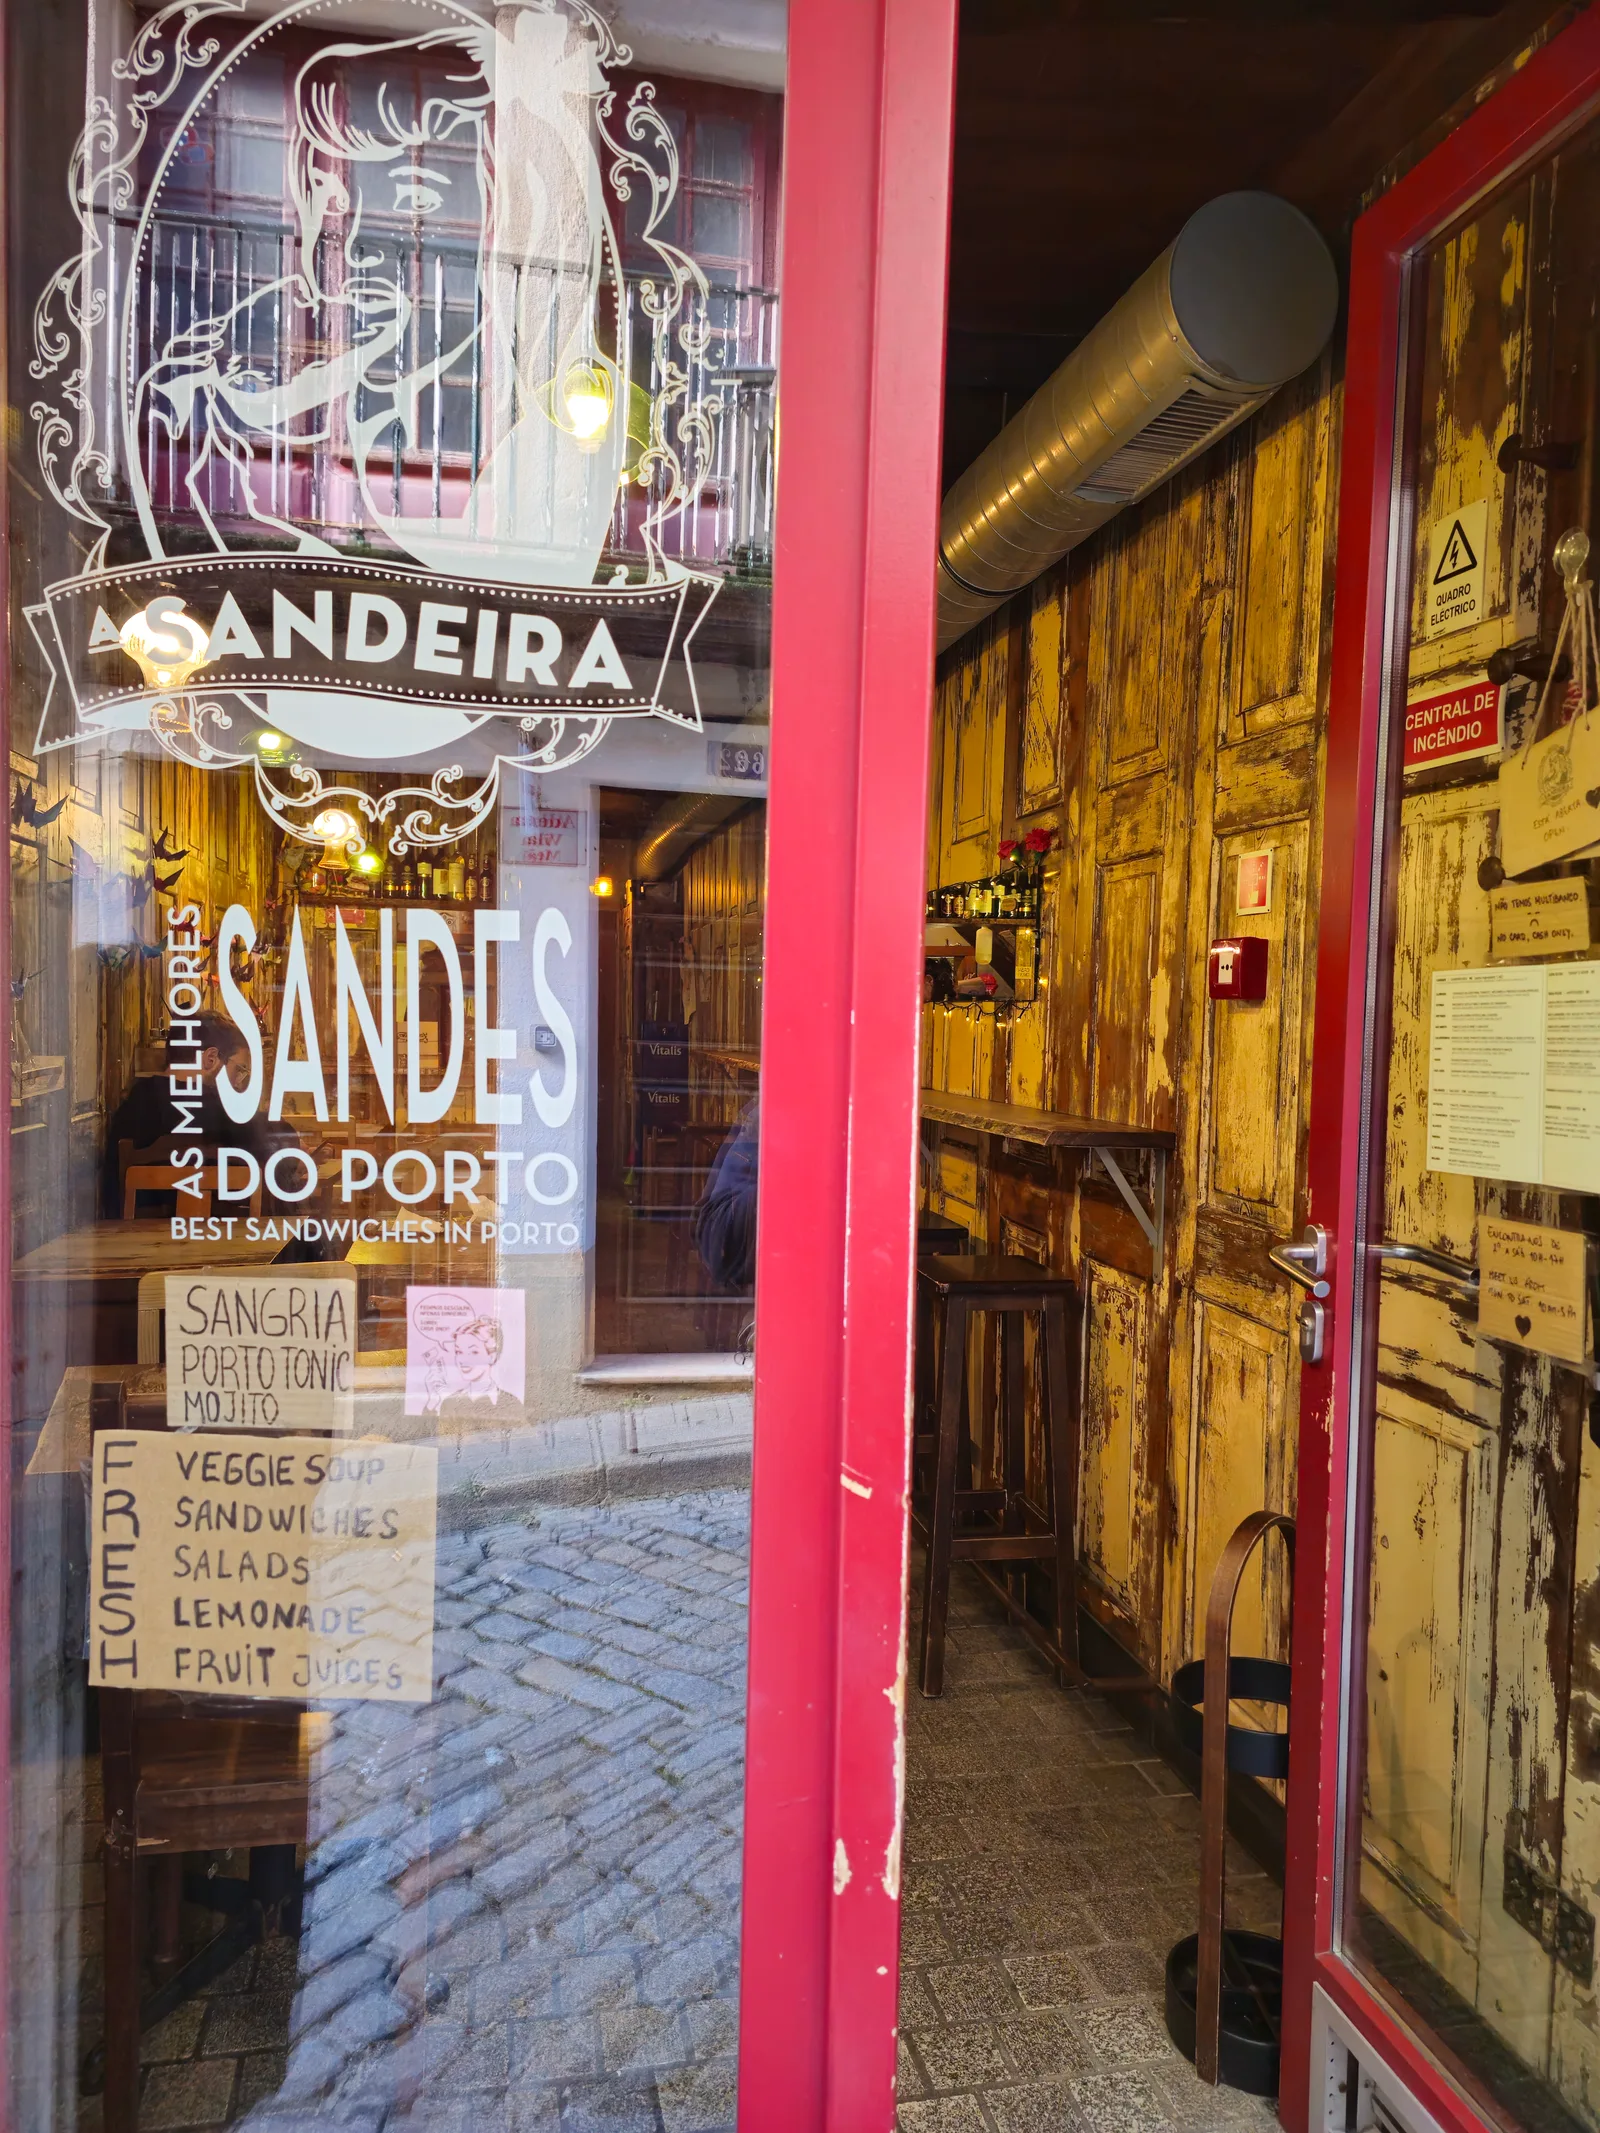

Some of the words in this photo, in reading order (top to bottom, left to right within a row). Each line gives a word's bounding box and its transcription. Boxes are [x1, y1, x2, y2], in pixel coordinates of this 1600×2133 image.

[1430, 599, 1476, 626] ELÉCTRICO
[1436, 583, 1471, 607] QUADRO
[145, 588, 632, 690] SANDEIRA
[1405, 698, 1471, 731] CENTRAL
[1473, 690, 1495, 712] DE
[1413, 720, 1482, 754] INCÊNDIO
[1497, 933, 1506, 943] NO
[1532, 930, 1549, 940] CASH
[170, 903, 202, 1134] MELHORES
[216, 903, 578, 1129] SANDES
[649, 1043, 682, 1056] Vitalis
[648, 1091, 680, 1104] Vitalis
[170, 1147, 203, 1200] AS
[217, 1147, 318, 1203] DO
[341, 1149, 578, 1206] PORTO
[170, 1217, 236, 1241] BEST
[244, 1217, 437, 1244] SANDWICHES
[444, 1220, 471, 1243] IN
[480, 1220, 579, 1246] PORTO
[179, 1285, 348, 1343] SANGRIA
[181, 1344, 275, 1389] PORTO
[184, 1392, 279, 1426] MOJITO
[176, 1450, 295, 1488] VEGGIE
[303, 1453, 385, 1487] SOUP
[174, 1496, 399, 1540] SANDWICHES
[99, 1440, 141, 1680] FRESH
[173, 1545, 311, 1586] SALADS
[173, 1598, 367, 1636] LEMONADE
